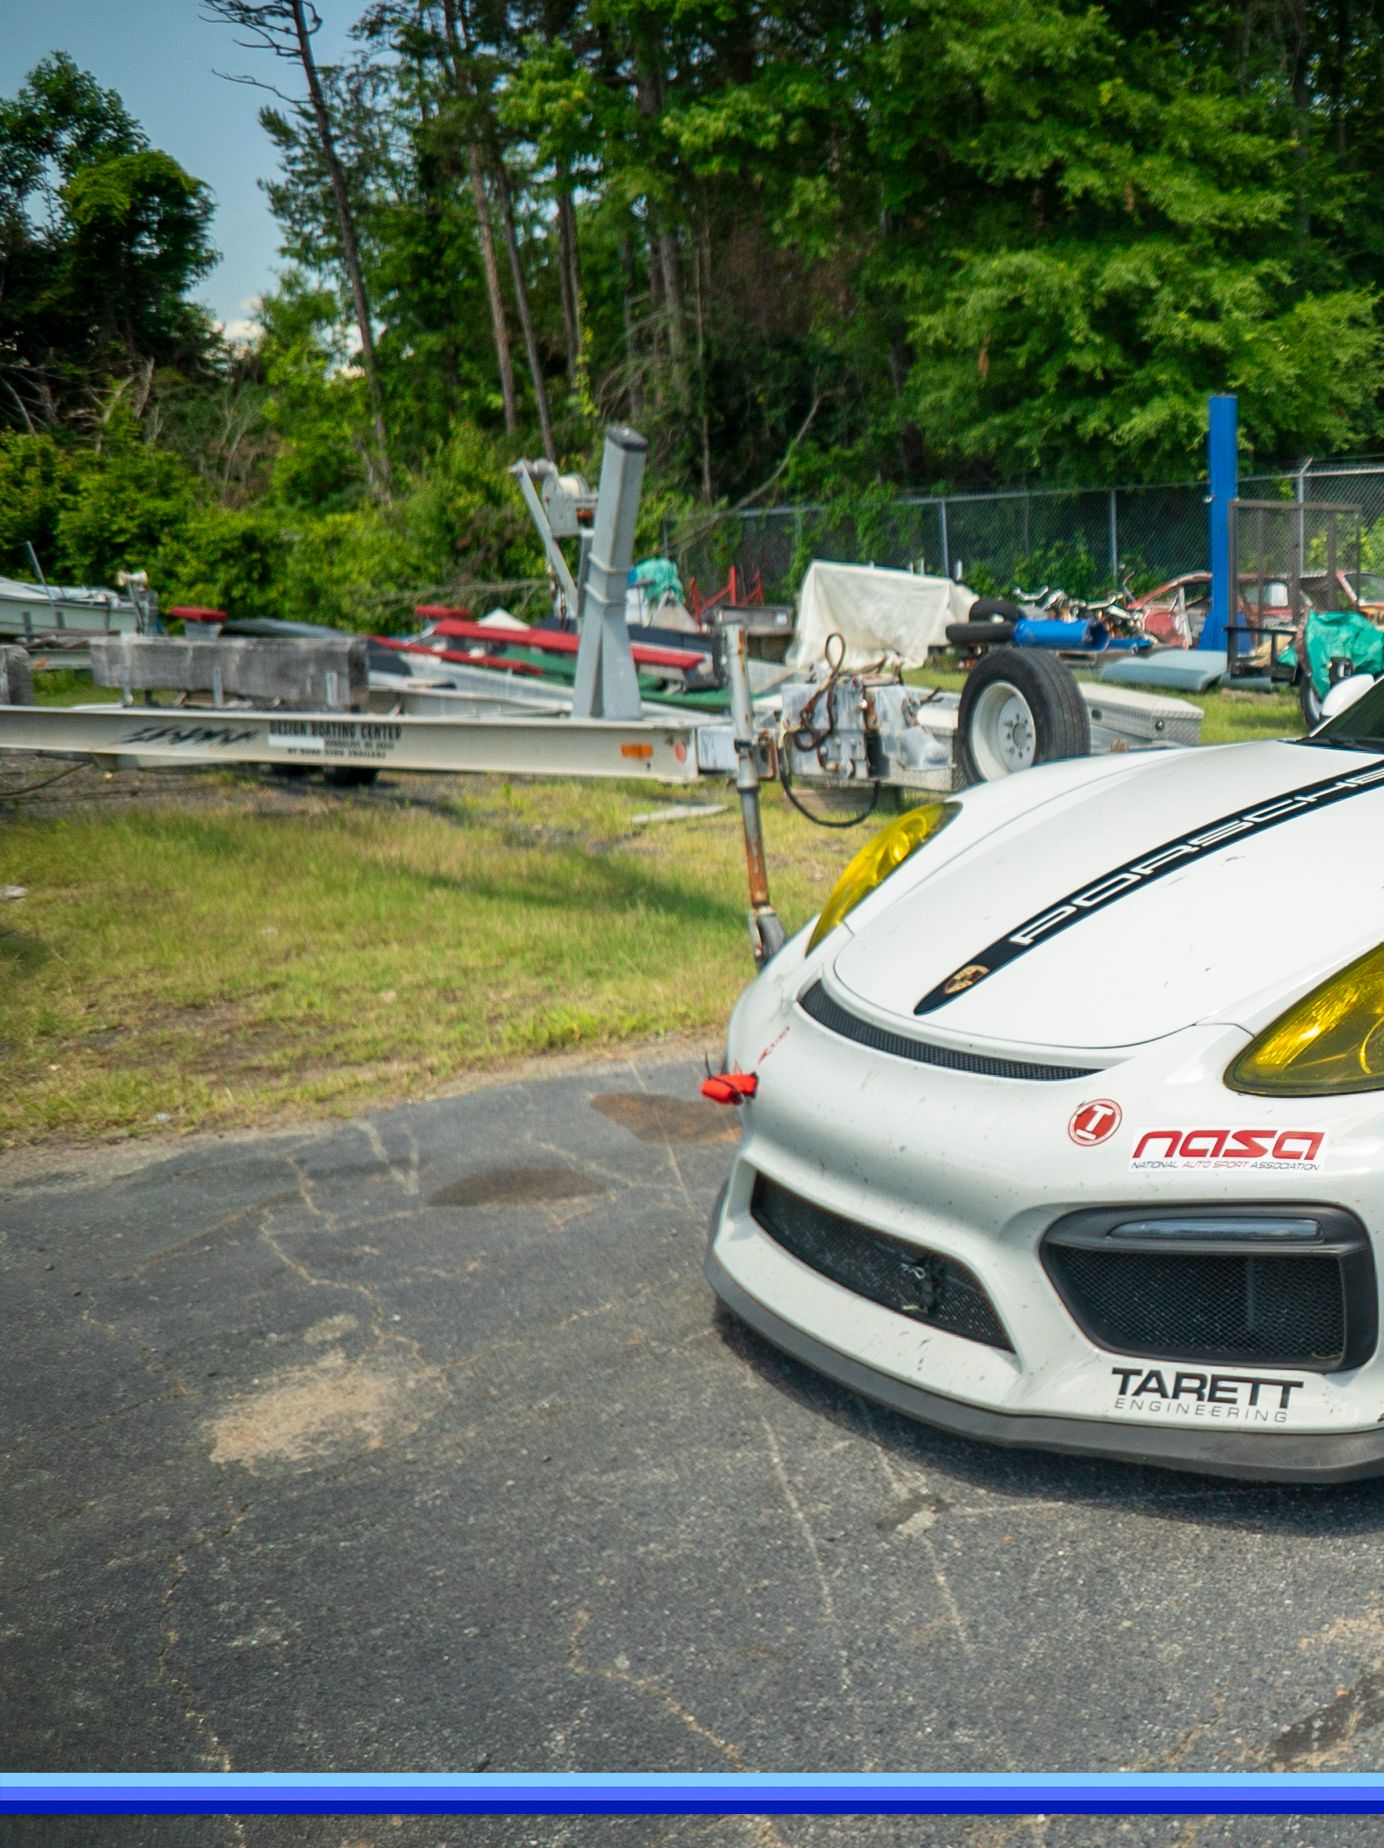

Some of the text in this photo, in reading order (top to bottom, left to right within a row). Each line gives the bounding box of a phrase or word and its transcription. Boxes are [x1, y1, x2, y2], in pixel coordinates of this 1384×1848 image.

[1131, 1160, 1320, 1172] NATIONAL AUTO SPORT ASSOCIATION
[1111, 1366, 1305, 1410] TARETT
[1114, 1397, 1288, 1424] ENGINEERING
